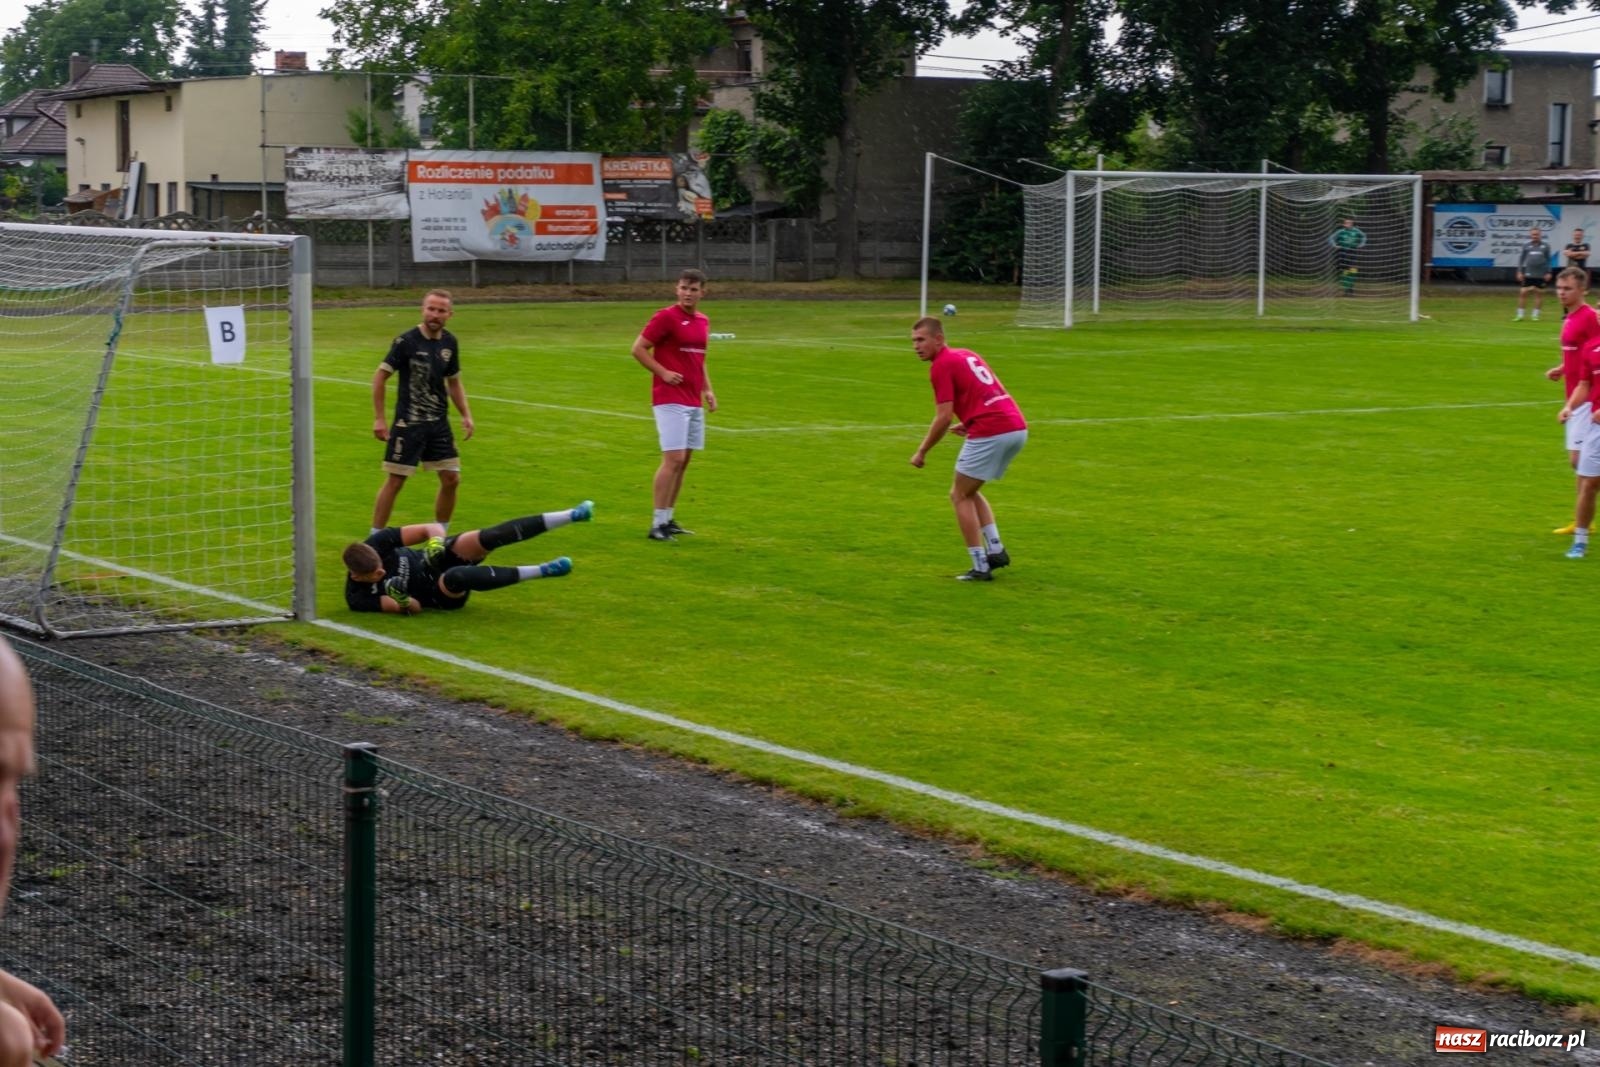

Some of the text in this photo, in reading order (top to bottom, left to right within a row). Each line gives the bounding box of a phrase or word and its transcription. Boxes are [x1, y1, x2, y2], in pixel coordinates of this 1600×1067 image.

[416, 164, 555, 181] Rozliczenie podatku
[604, 160, 668, 171] KREWETKA
[1435, 229, 1487, 238] S-SERWIS
[220, 321, 236, 343] B
[966, 356, 994, 386] 6
